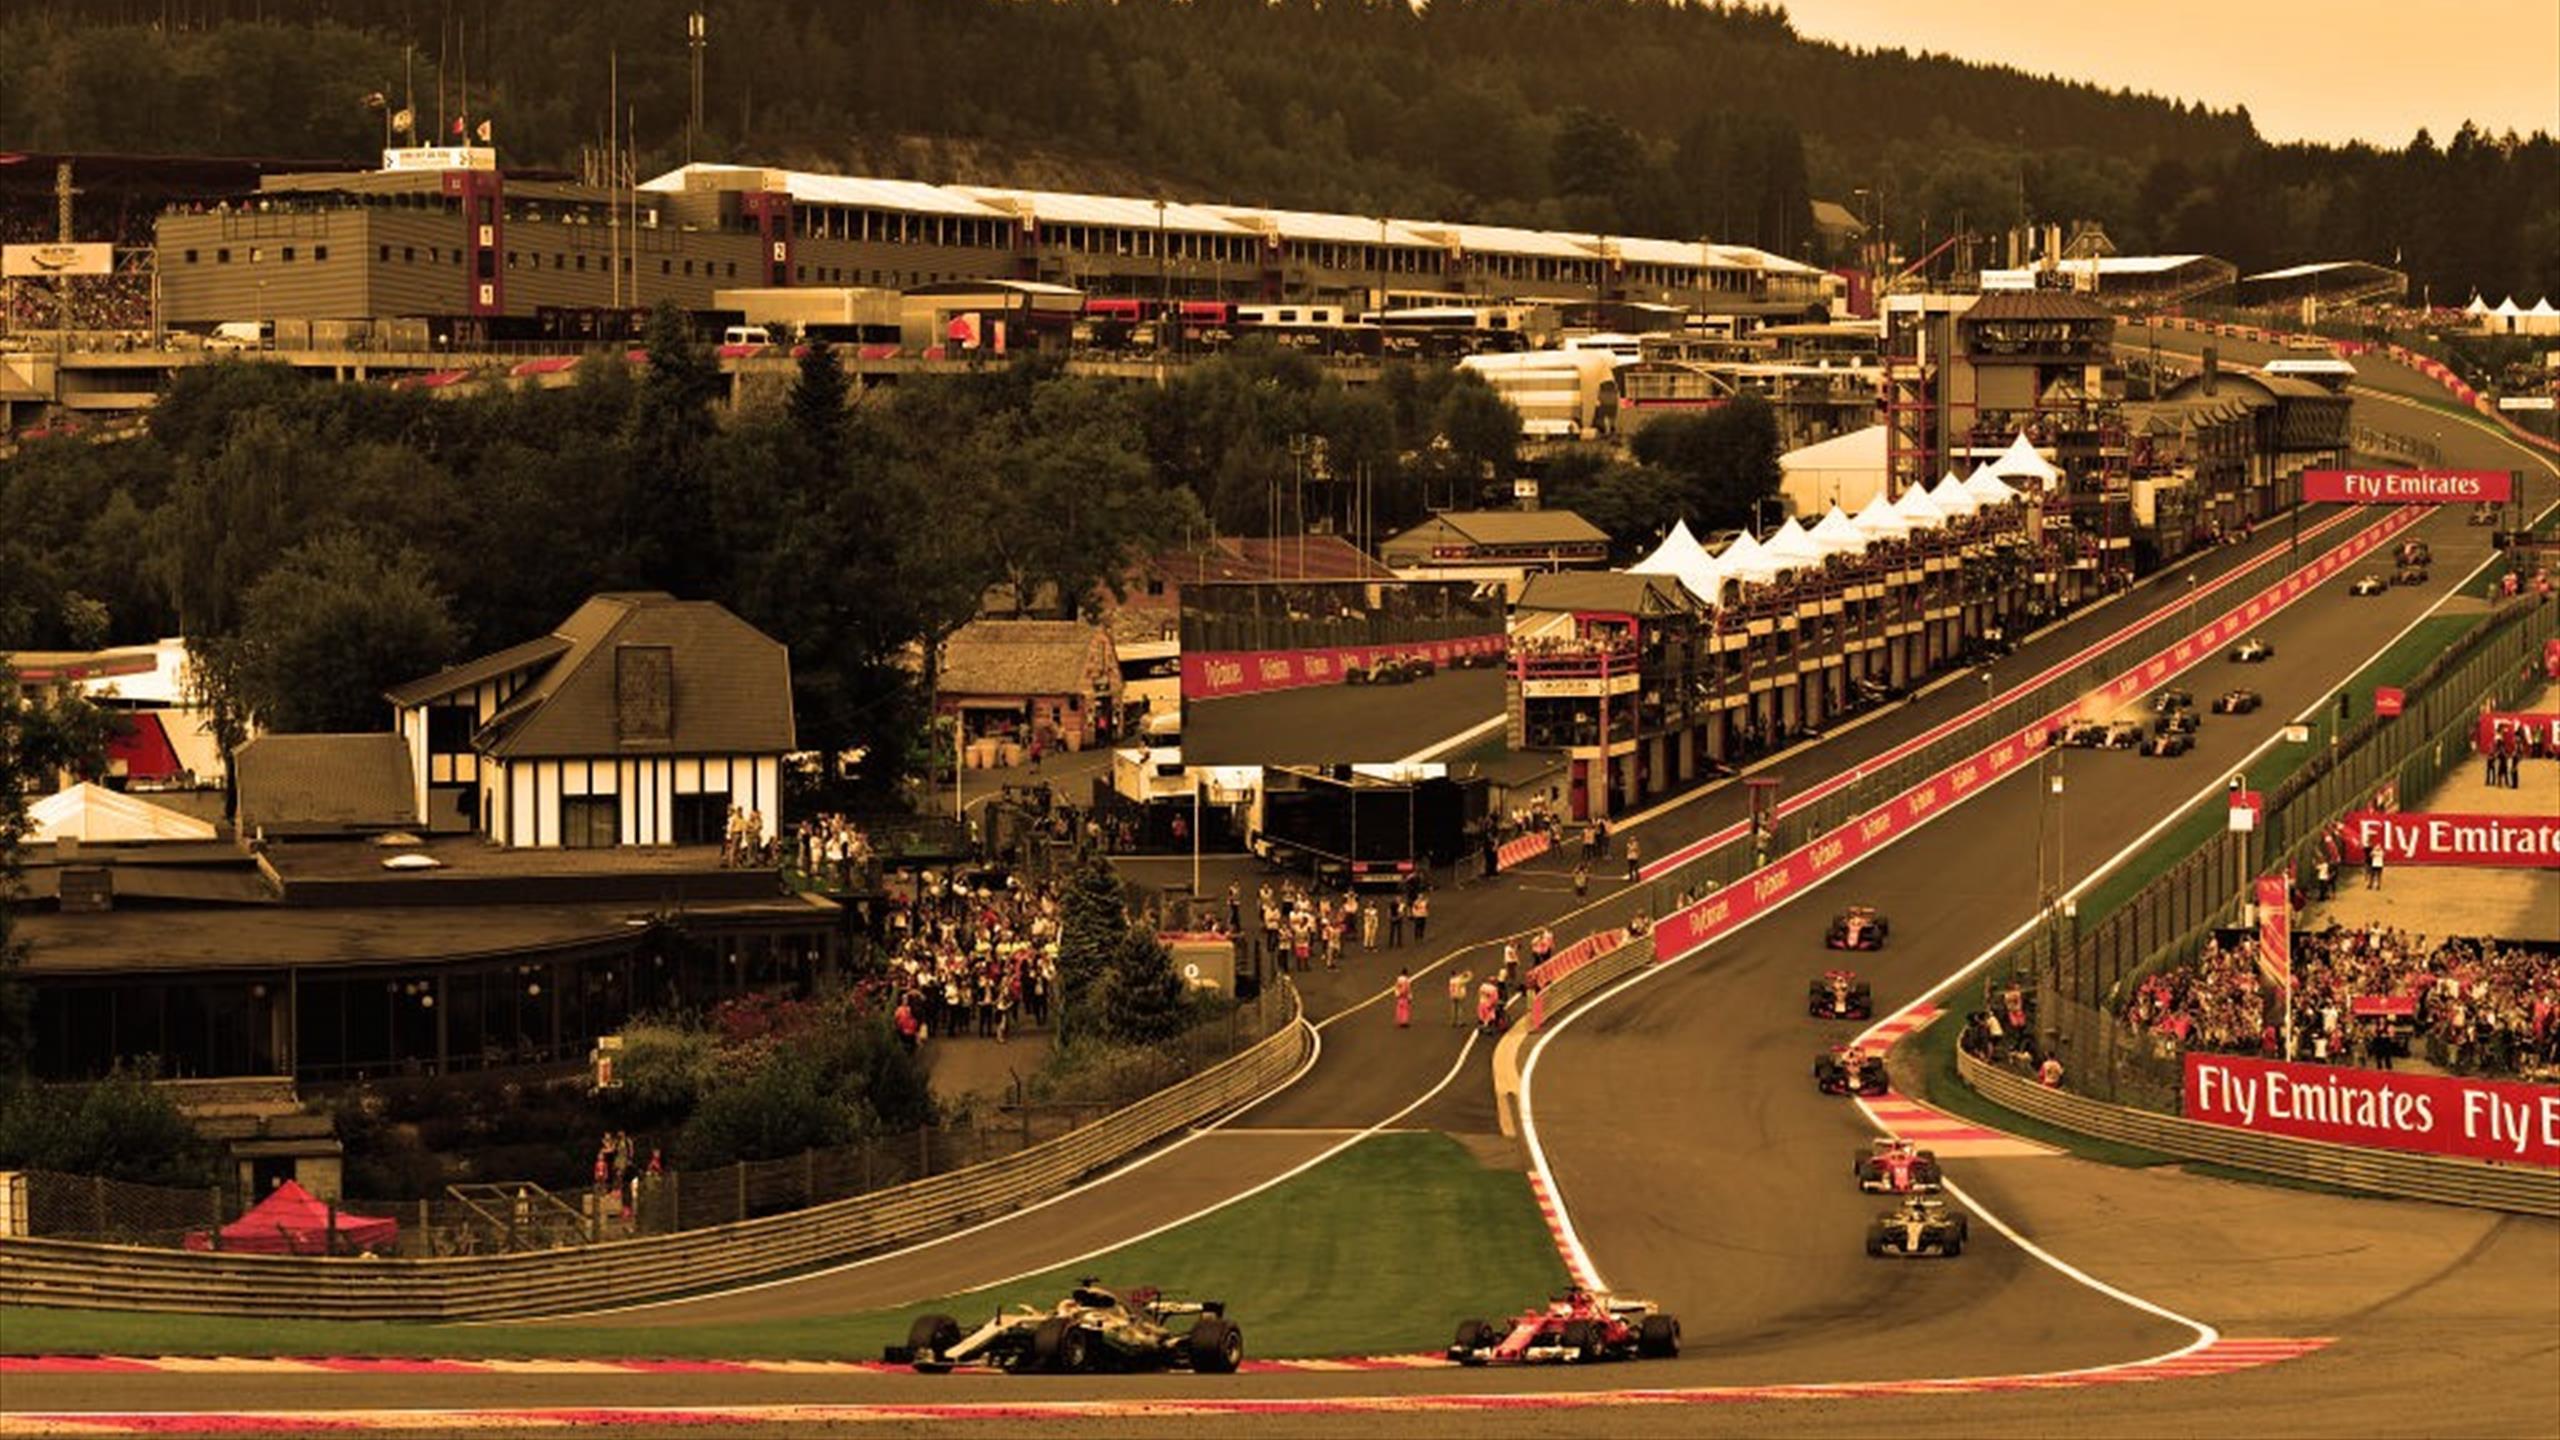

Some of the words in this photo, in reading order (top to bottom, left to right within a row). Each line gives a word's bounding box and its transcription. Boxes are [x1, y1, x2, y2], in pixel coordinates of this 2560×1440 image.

[2345, 475, 2381, 497] Fly
[2386, 474, 2481, 495] Emirates
[2360, 820, 2420, 858] Fly
[2198, 1064, 2256, 1125] Fly
[2265, 1071, 2433, 1133] Emirates
[2463, 1089, 2530, 1153] Fly
